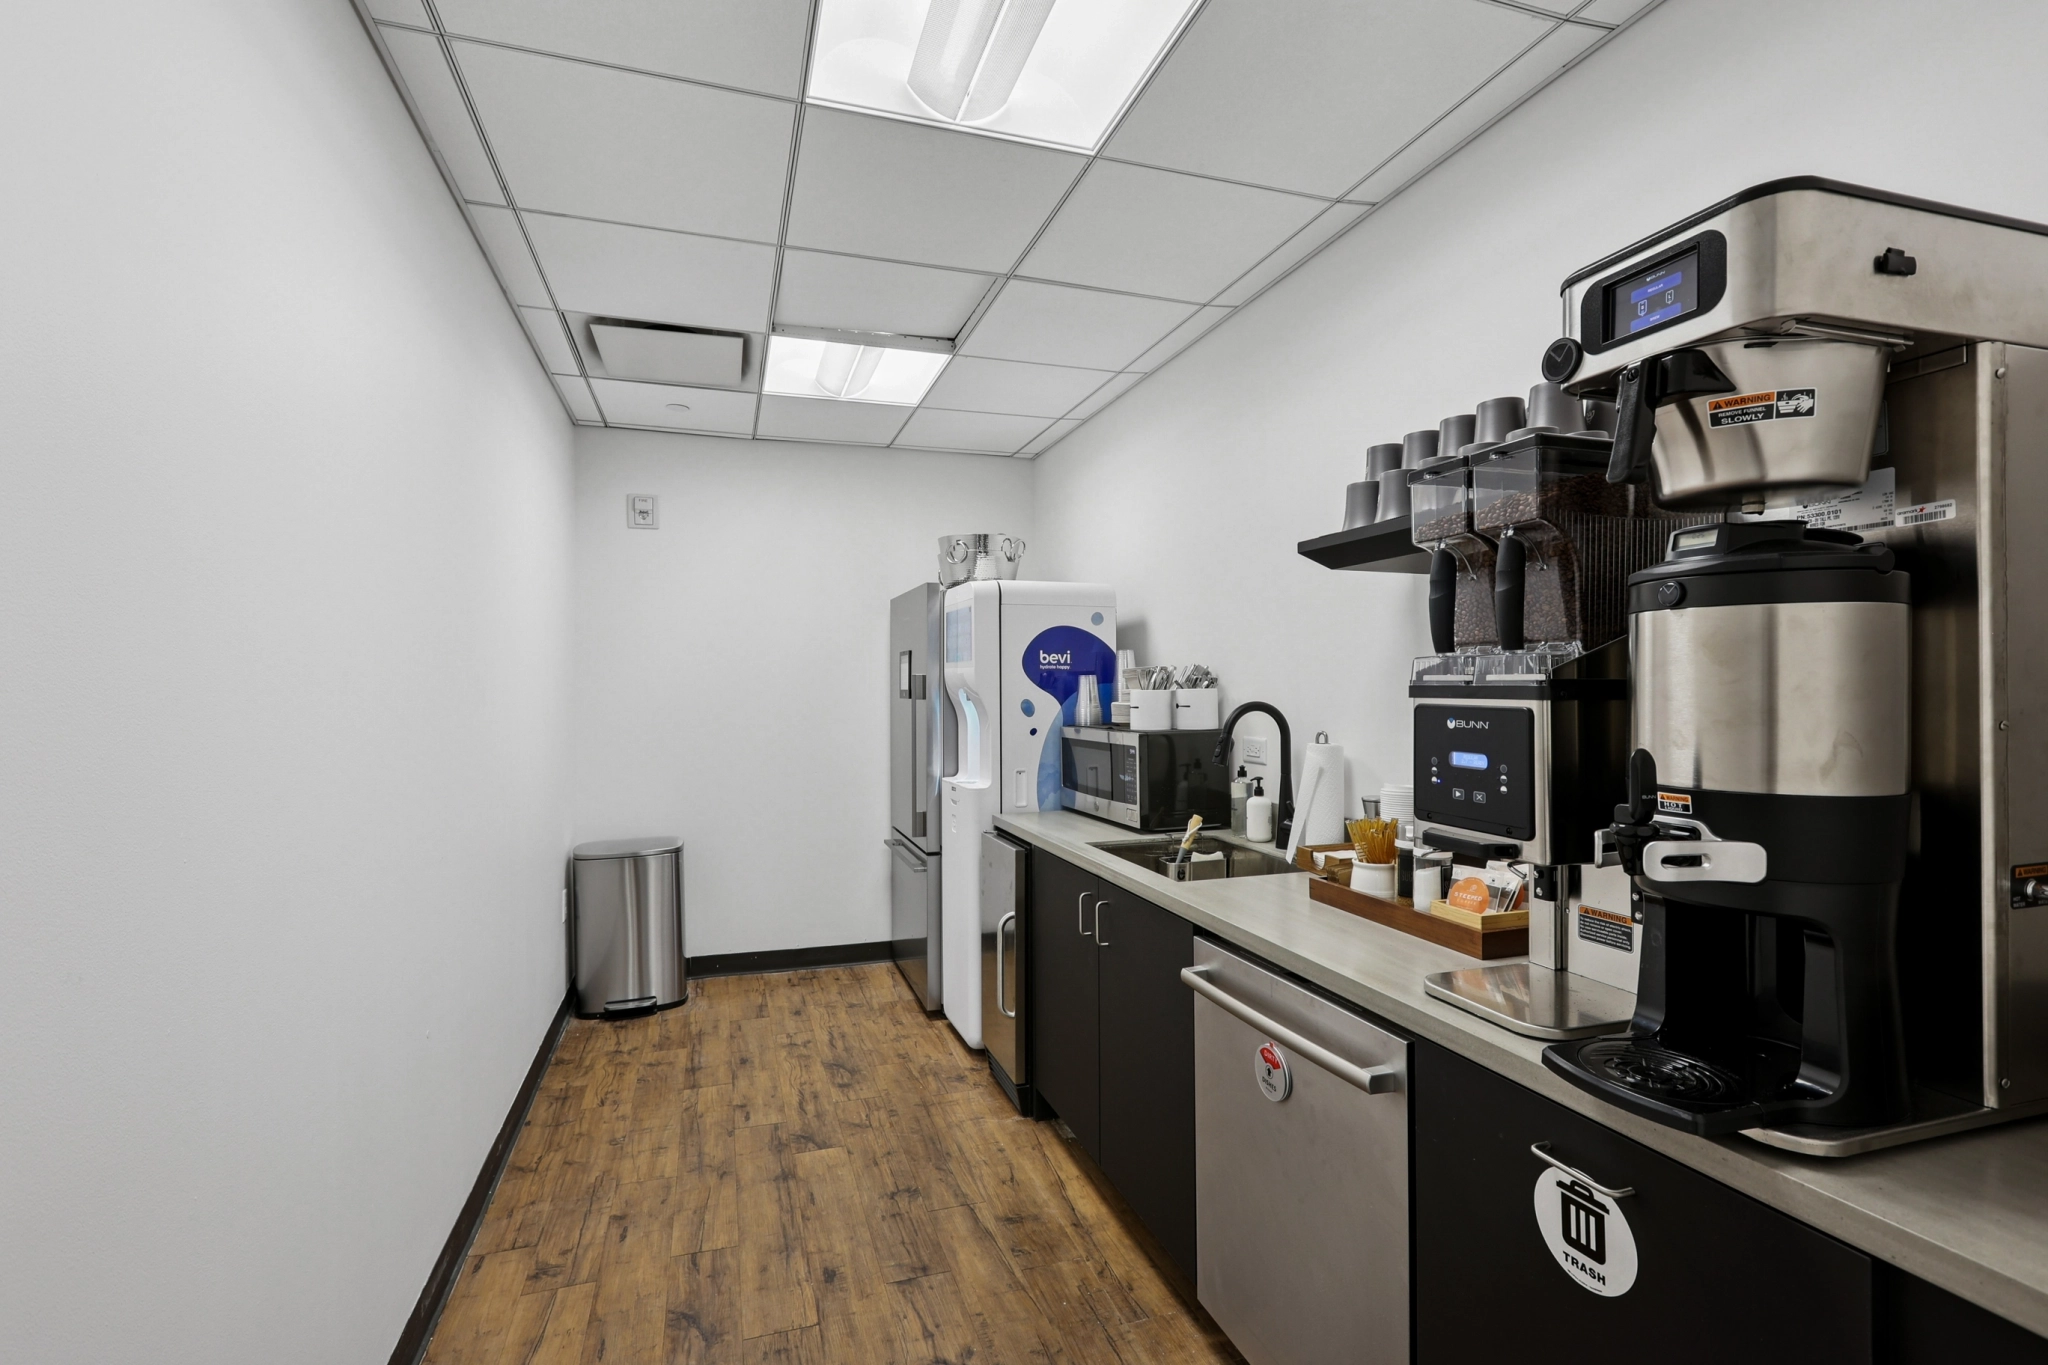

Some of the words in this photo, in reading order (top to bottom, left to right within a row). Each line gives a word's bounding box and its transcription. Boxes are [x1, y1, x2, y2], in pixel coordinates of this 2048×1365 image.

[1724, 394, 1770, 407] WARNING
[1743, 406, 1766, 414] FUNNEL
[1721, 413, 1764, 424] SLOWLY
[1456, 719, 1489, 729] BUNN
[1454, 892, 1482, 901] STEEPED
[1591, 909, 1627, 923] WARNING
[1563, 1251, 1605, 1286] TRASH
